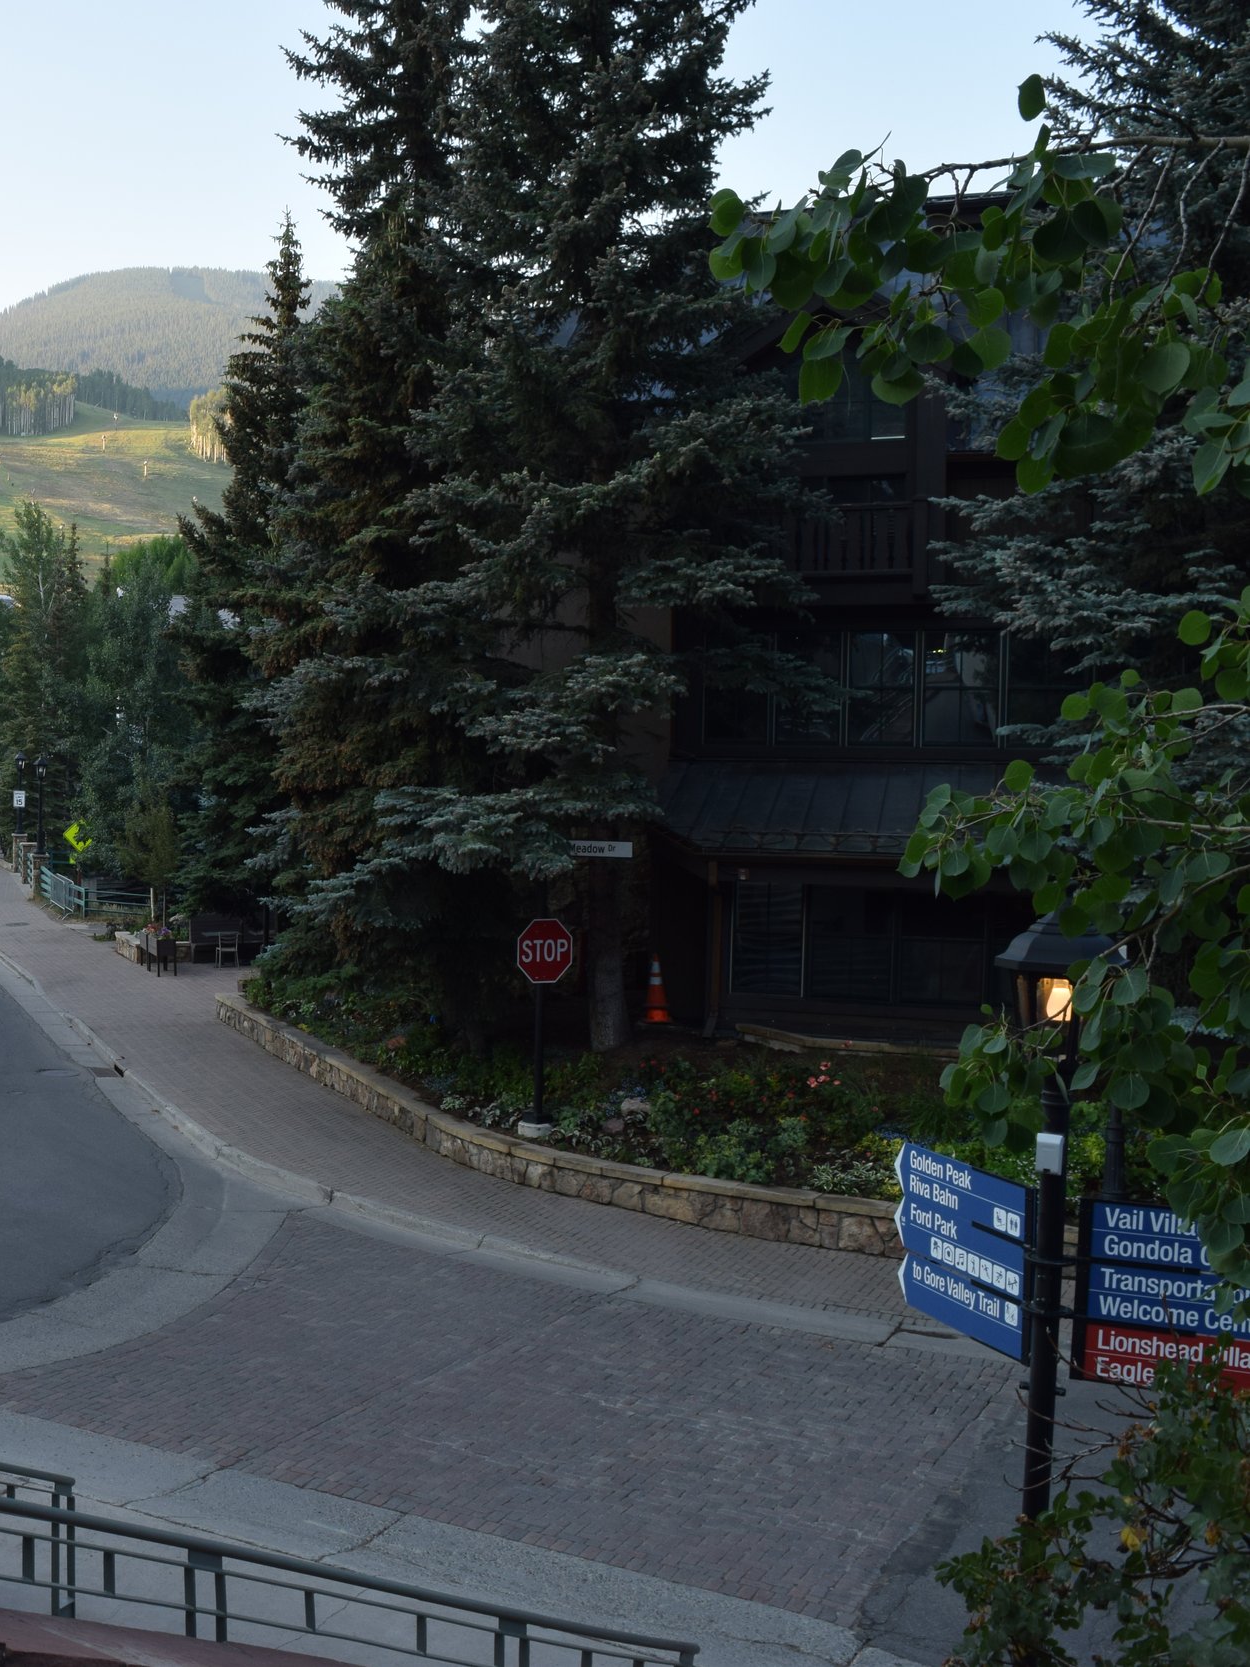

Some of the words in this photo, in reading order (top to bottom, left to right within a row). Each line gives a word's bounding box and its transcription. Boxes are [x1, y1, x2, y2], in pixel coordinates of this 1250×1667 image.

[521, 939, 568, 963] STOP
[910, 1150, 943, 1179] Golden
[946, 1163, 972, 1190] Peak
[910, 1174, 931, 1199] Riva
[932, 1183, 958, 1210] Bahn
[910, 1203, 932, 1228] Ford
[934, 1213, 958, 1240] Park
[1105, 1207, 1144, 1231] Vail
[1104, 1234, 1193, 1264] Gondola
[912, 1260, 922, 1280] to
[924, 1266, 945, 1292] Gore
[947, 1276, 976, 1310] Valley
[978, 1291, 1000, 1319] Trail
[1099, 1295, 1199, 1327] Welcome
[1205, 1308, 1250, 1334] Cen
[1097, 1329, 1204, 1363] Lionshead
[1095, 1356, 1155, 1387] Eagle
